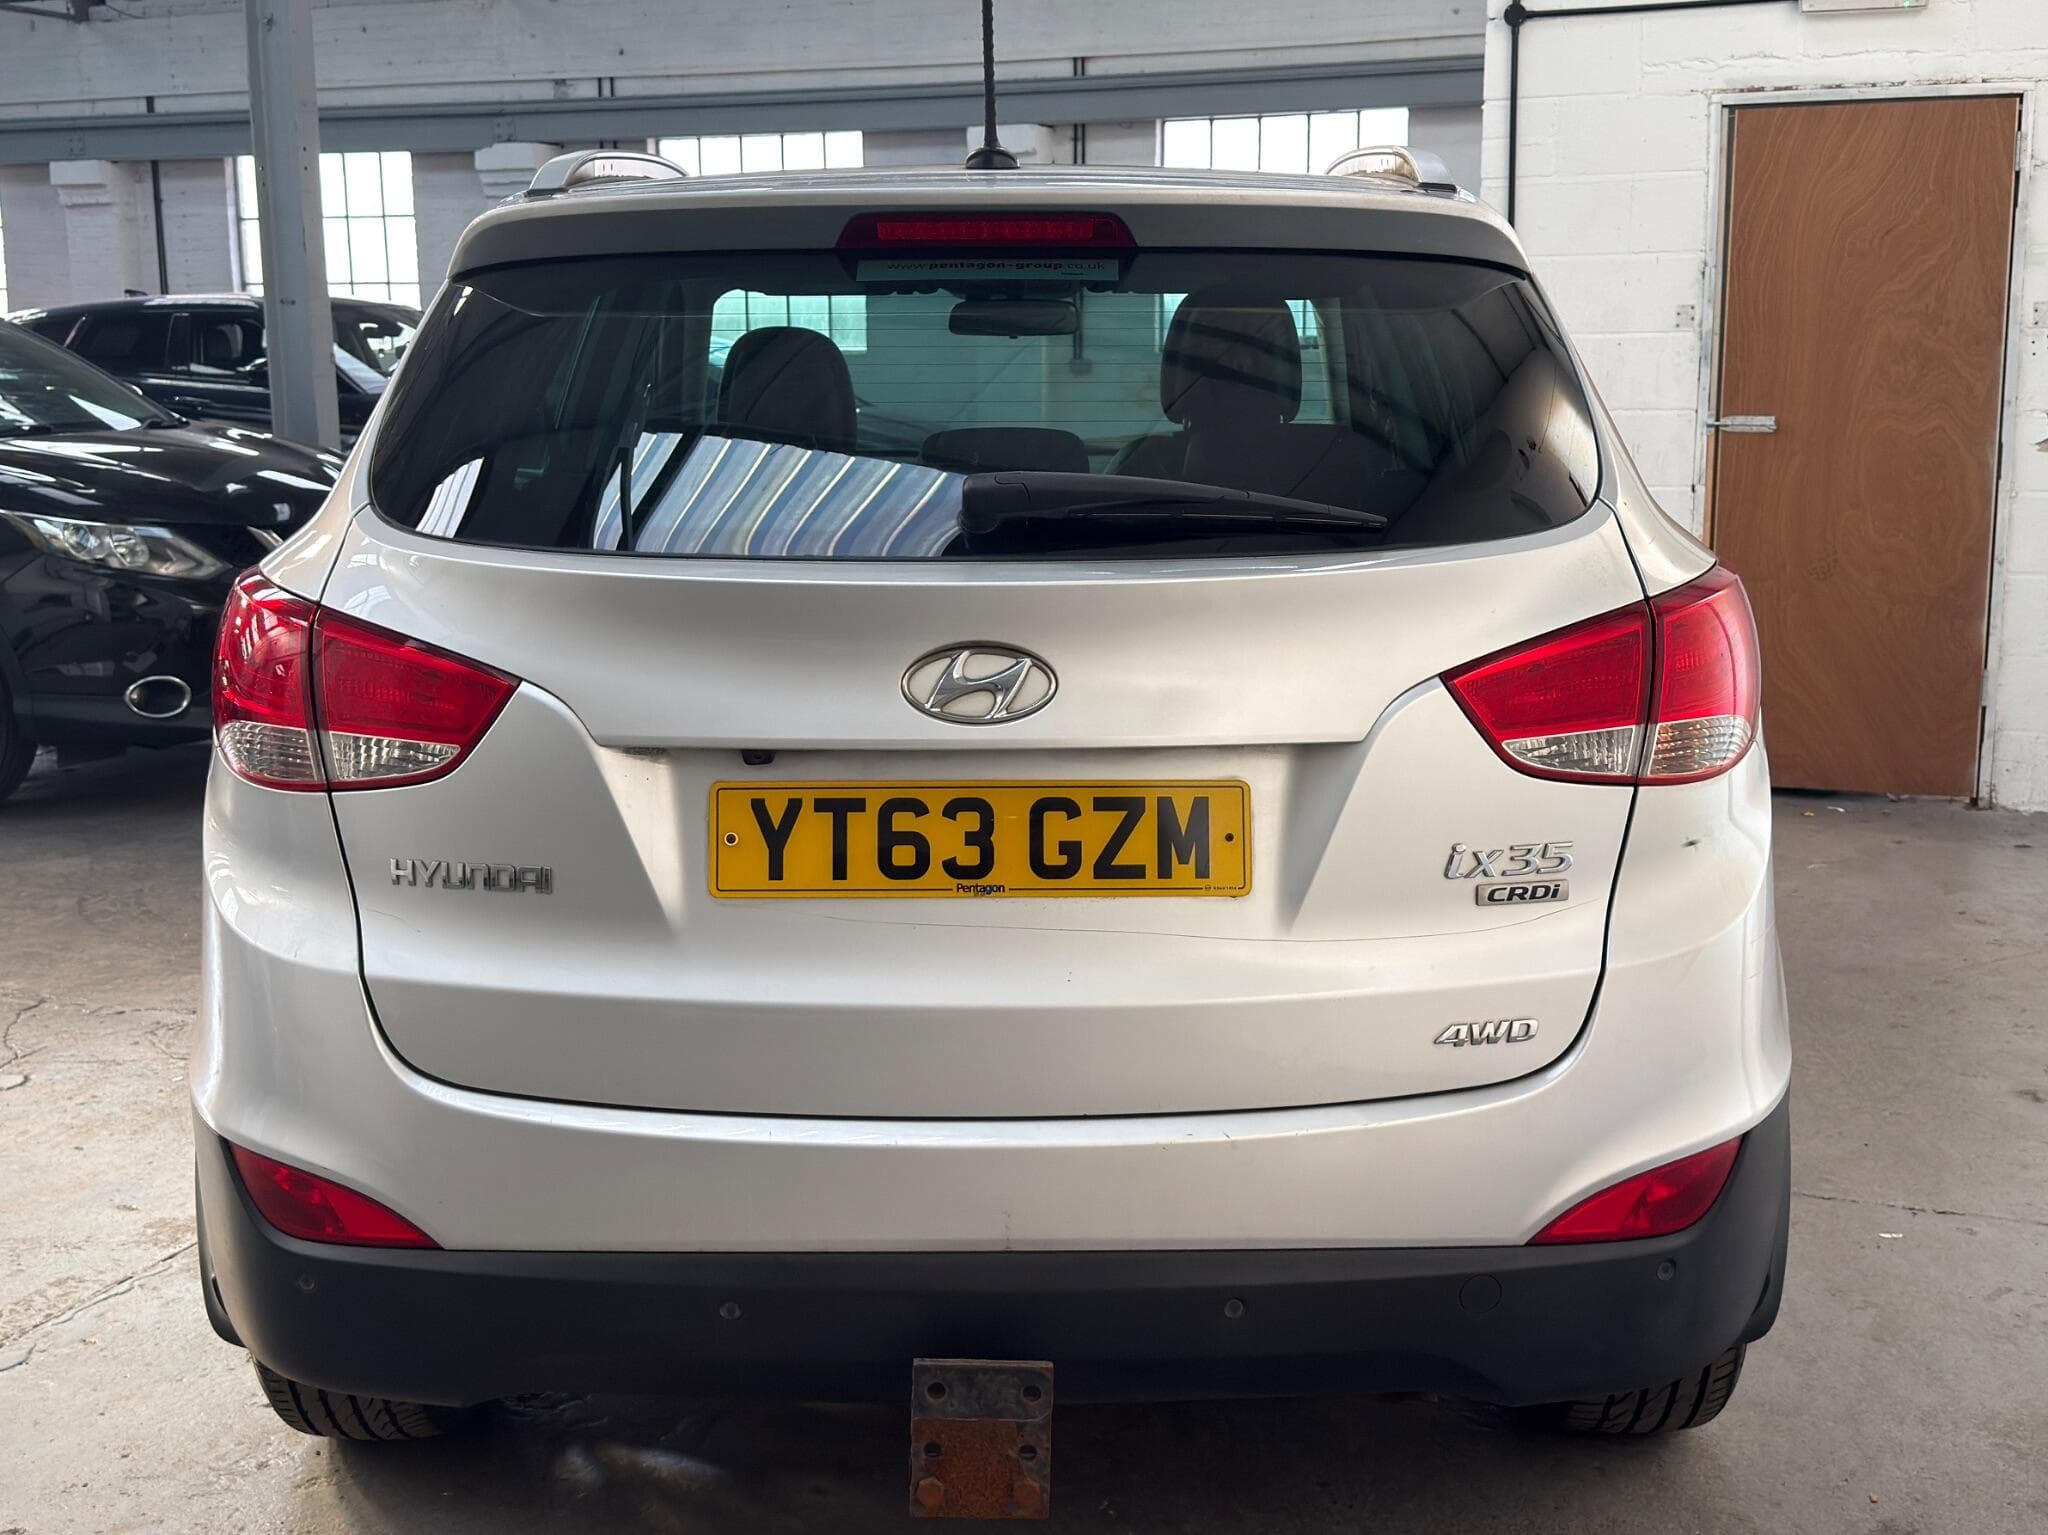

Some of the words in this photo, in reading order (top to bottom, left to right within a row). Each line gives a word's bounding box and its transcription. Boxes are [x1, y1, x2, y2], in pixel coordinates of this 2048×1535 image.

[750, 797, 995, 880] YT63
[1029, 796, 1210, 880] GZM
[390, 857, 553, 895] HYUNDAI
[1444, 841, 1574, 879] ix35
[956, 882, 1006, 895] Pentagon
[1487, 883, 1561, 902] CRDi
[1433, 1018, 1539, 1047] 4WD
